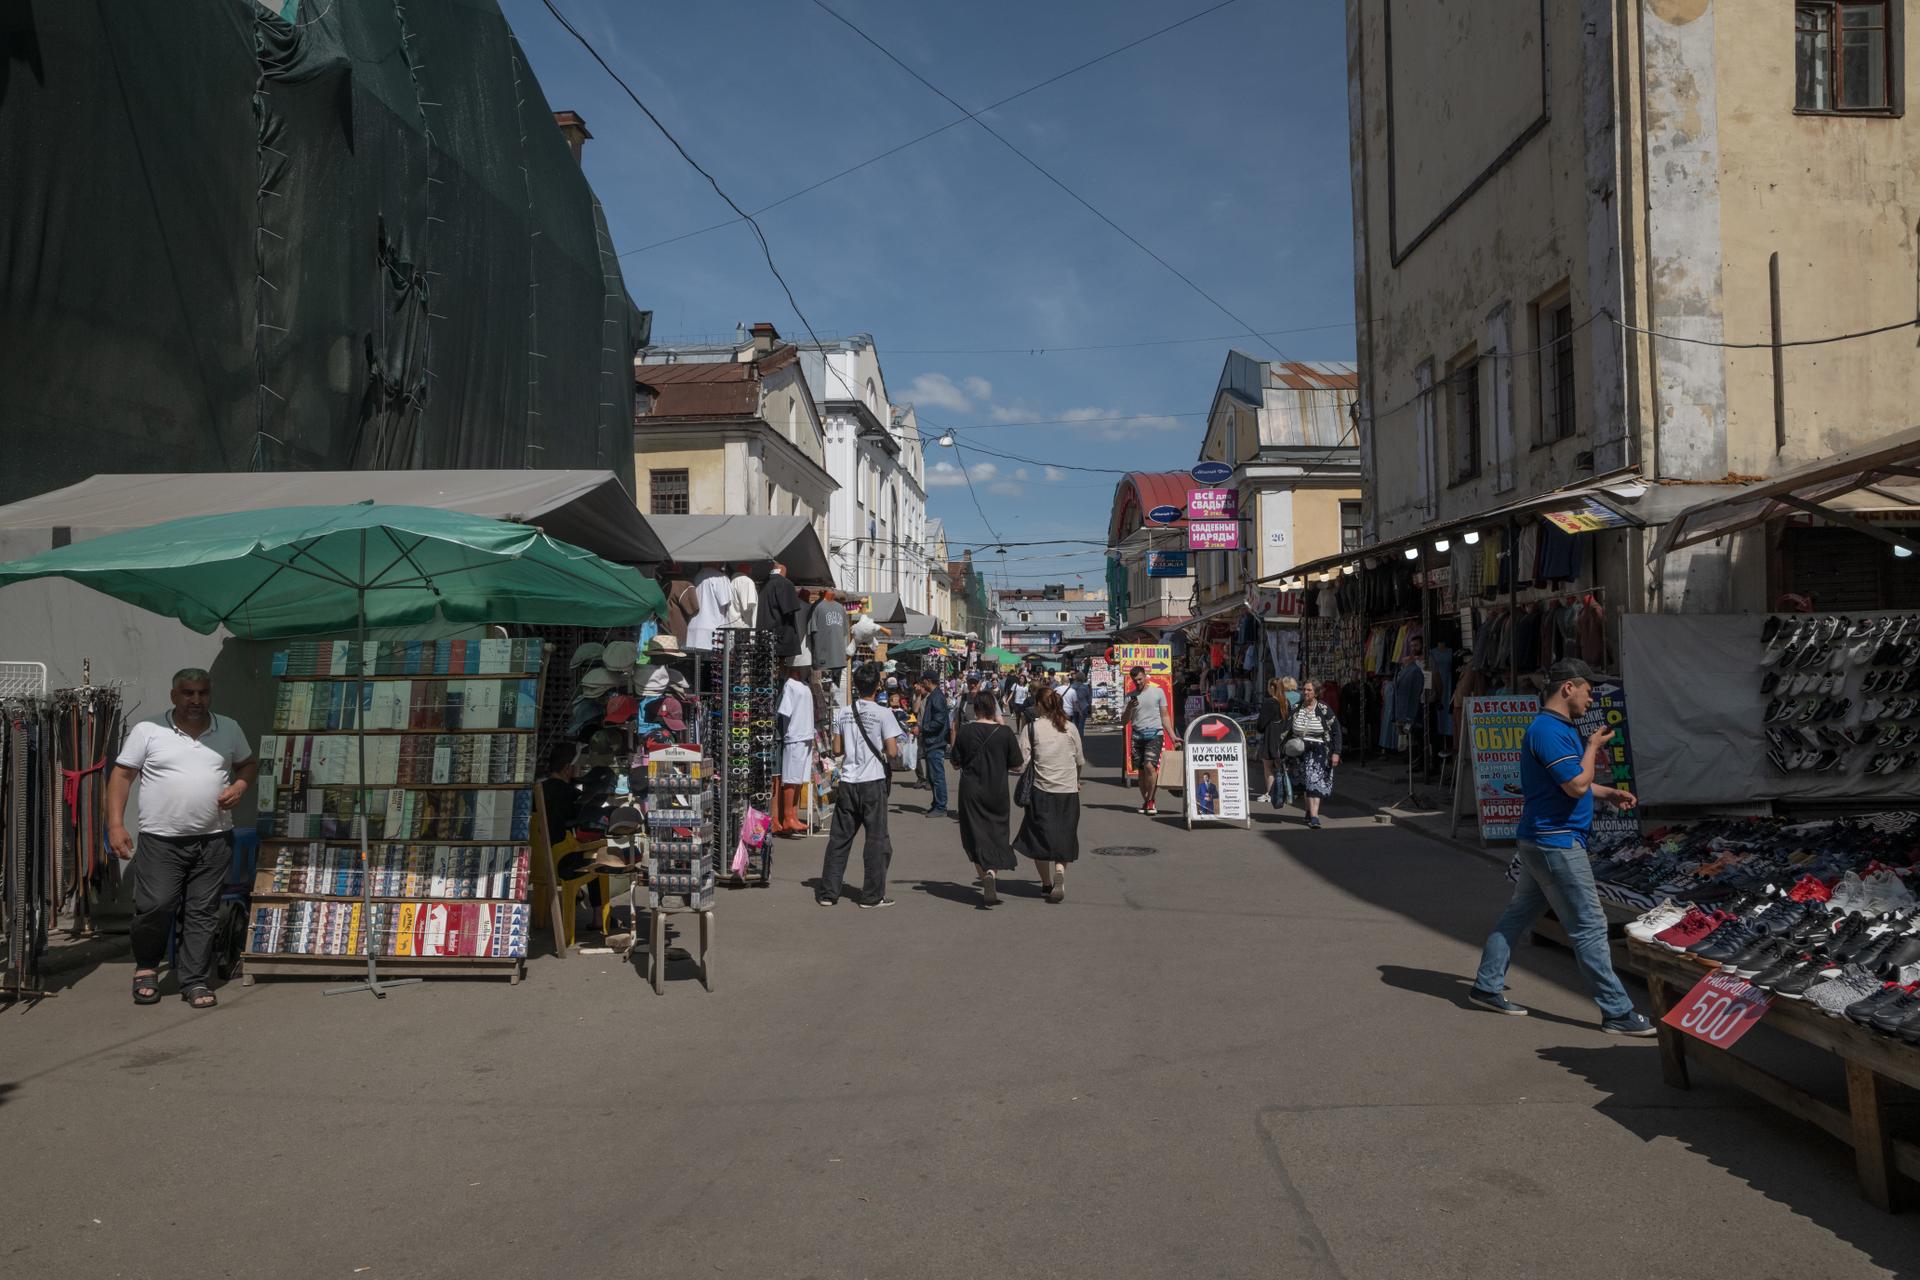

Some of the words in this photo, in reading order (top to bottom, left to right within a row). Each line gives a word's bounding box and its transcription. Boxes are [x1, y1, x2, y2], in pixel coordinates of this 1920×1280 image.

[1194, 491, 1214, 500] ВСЁ
[1191, 500, 1235, 510] СВАДЬБЫ
[1191, 523, 1235, 532] СВАДЕБНЫЕ
[1192, 532, 1235, 542] НАРЯДЫ
[1271, 533, 1284, 543] 26
[1122, 647, 1169, 658] ИГРУШКИ
[1473, 701, 1537, 713] ДЕТСКАЯ
[1600, 697, 1612, 707] 15
[1193, 754, 1239, 762] КОСТЮМЫ
[1592, 819, 1639, 831] ШКОЛЬНАЯ
[1681, 990, 1747, 1040] 500
